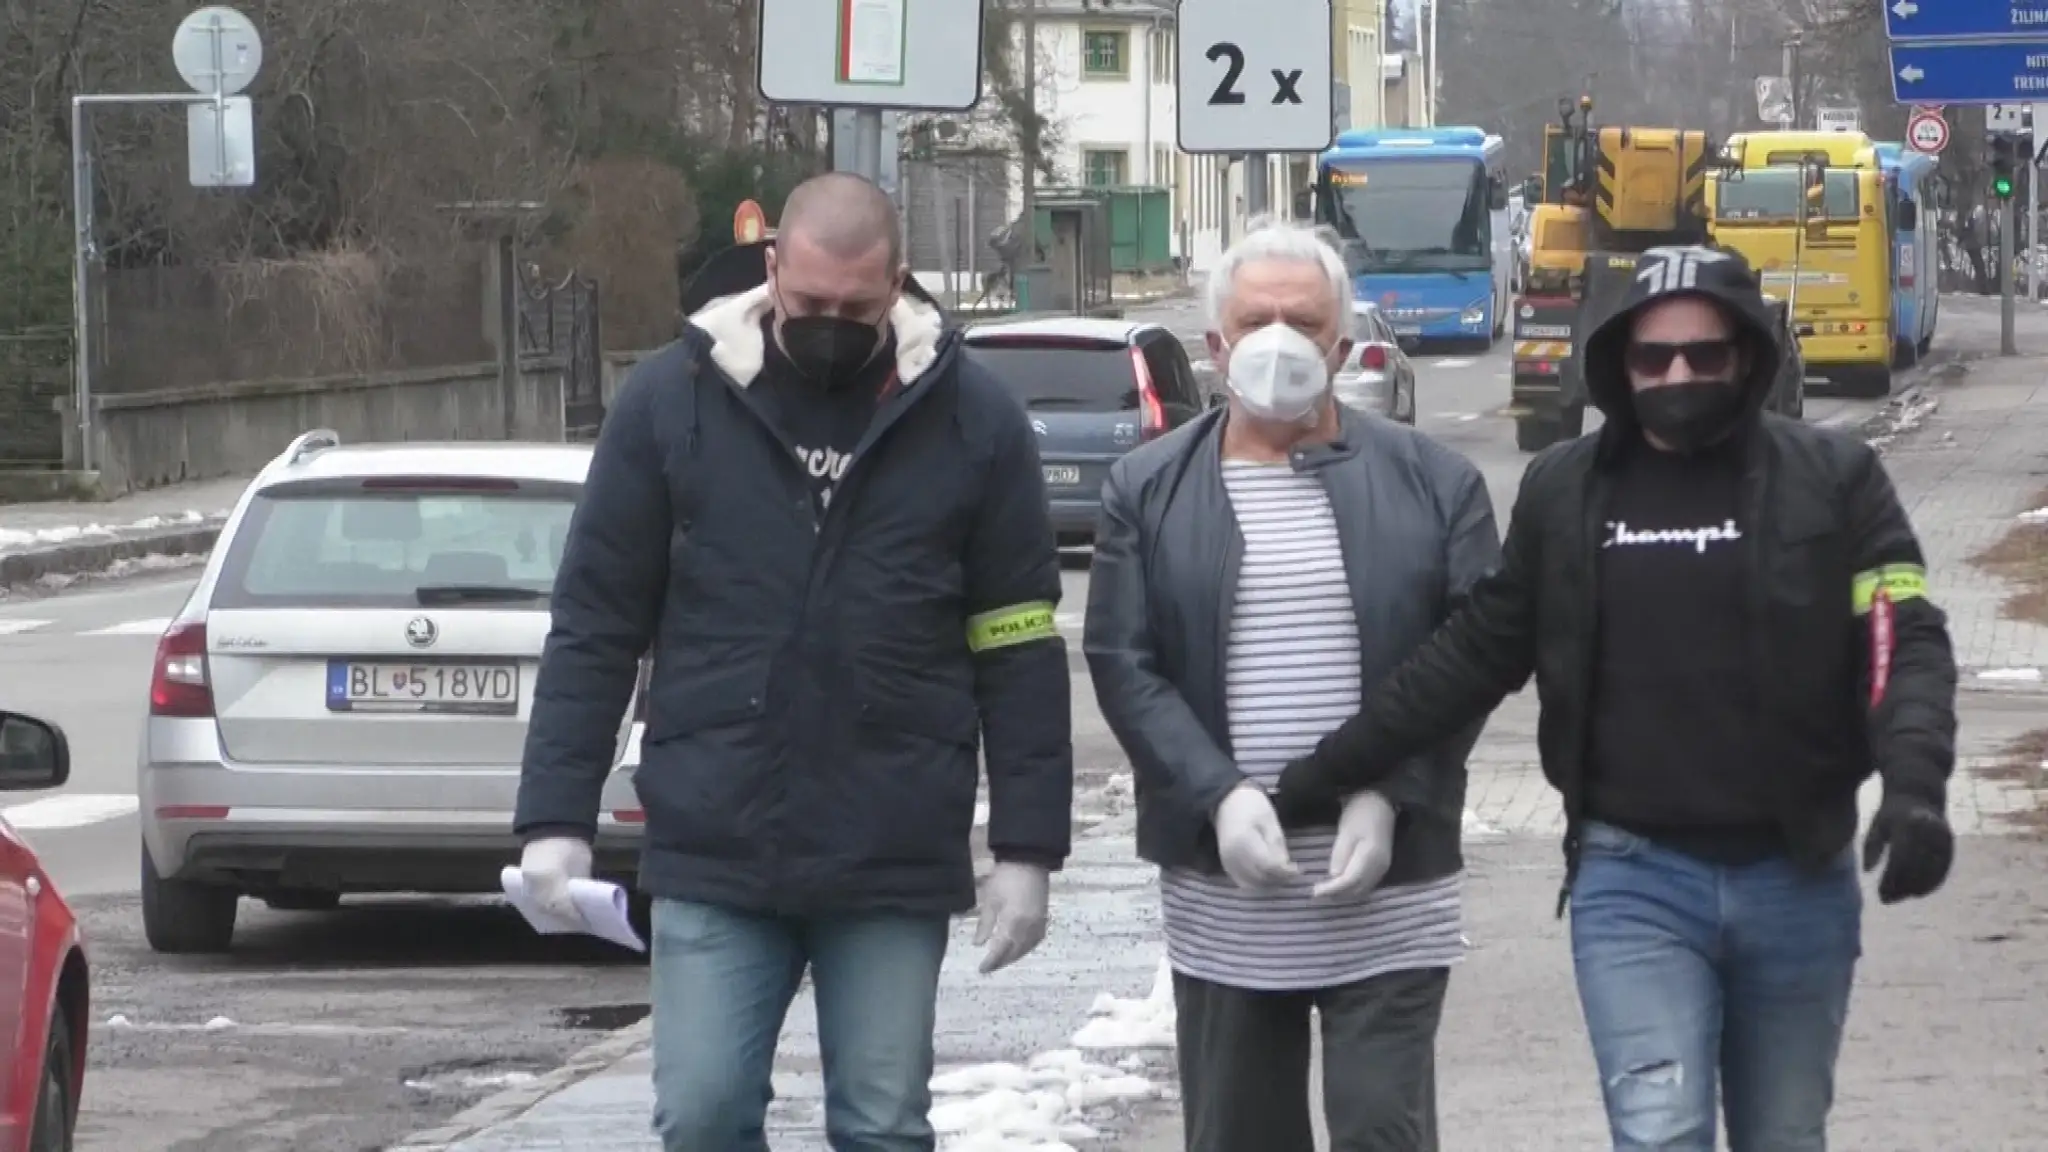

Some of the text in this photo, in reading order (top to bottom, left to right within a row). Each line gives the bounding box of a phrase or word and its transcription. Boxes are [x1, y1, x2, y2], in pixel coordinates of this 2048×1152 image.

[1205, 42, 1304, 106] 2 x
[2026, 55, 2048, 68] NIT
